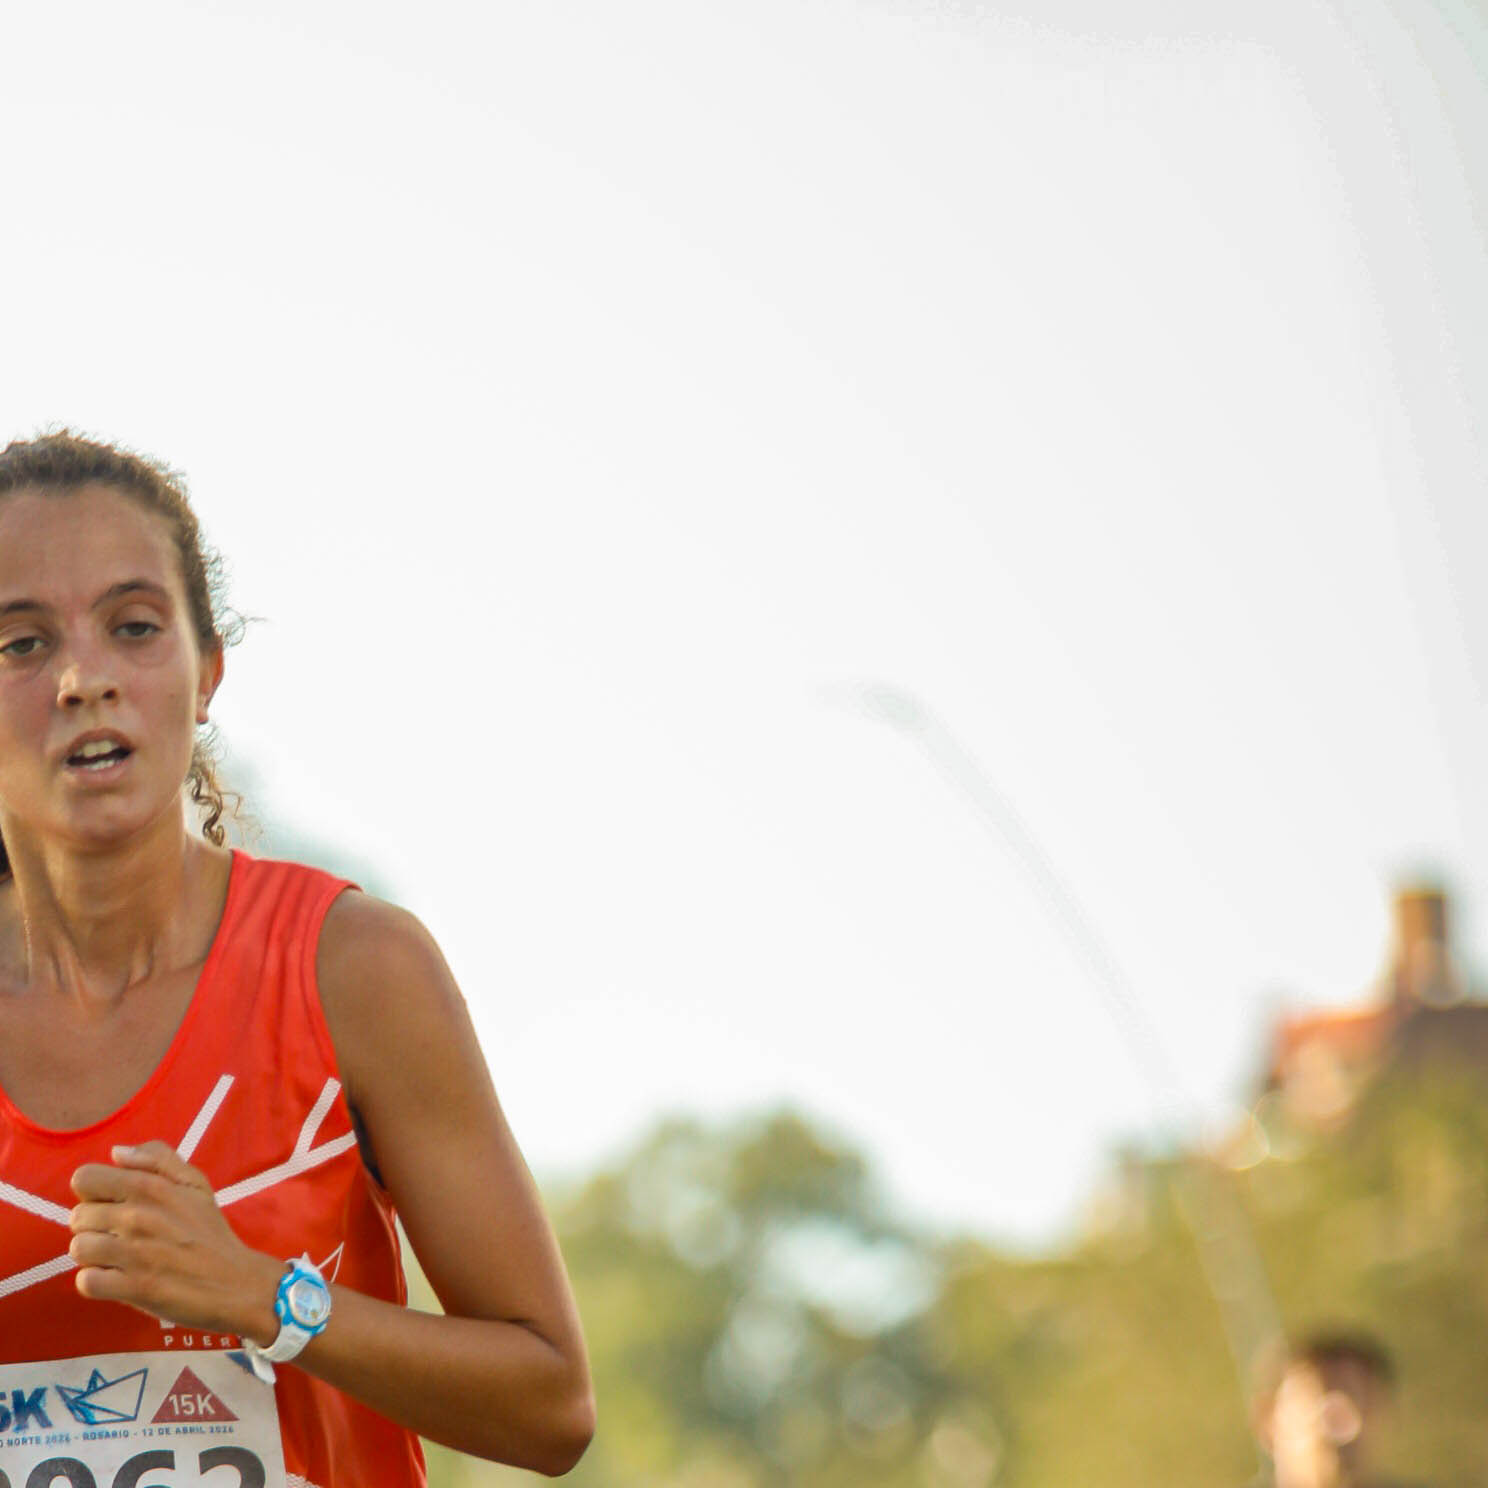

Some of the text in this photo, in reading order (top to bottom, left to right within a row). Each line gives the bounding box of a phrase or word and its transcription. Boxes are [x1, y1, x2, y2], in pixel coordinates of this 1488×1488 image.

[164, 1335, 241, 1347] PUER
[168, 1392, 216, 1416] 15K
[7, 1435, 41, 1448] NORTE
[82, 1430, 129, 1440] ROSARIO
[142, 1428, 154, 1437] 12
[158, 1427, 171, 1435] DE
[175, 1425, 206, 1435] ABRIL
[209, 1425, 235, 1434] 2026
